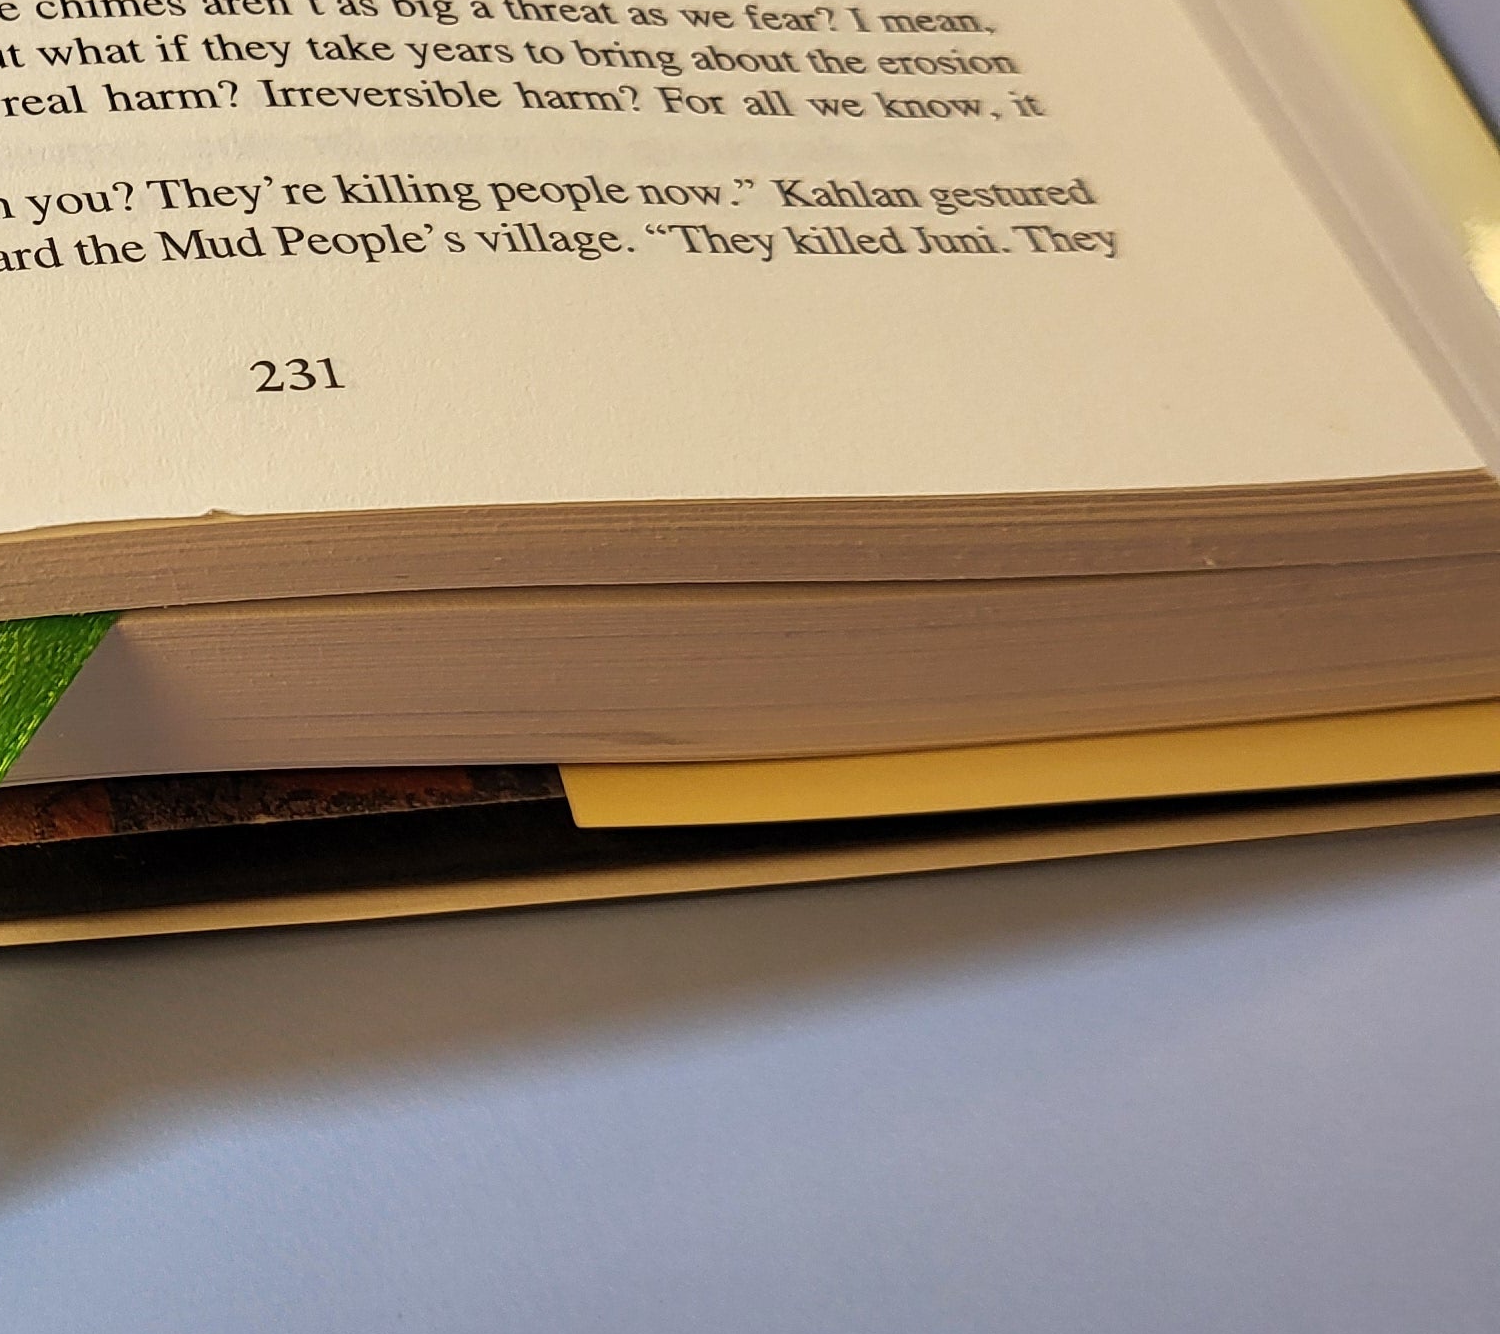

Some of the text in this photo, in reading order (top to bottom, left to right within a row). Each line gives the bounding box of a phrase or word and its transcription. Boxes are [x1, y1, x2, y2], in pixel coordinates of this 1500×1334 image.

[470, 0, 495, 20] a
[627, 6, 669, 27] as
[678, 9, 735, 29] we
[744, 2, 839, 32] fear?
[844, 6, 872, 33] I
[877, 14, 999, 36] mean,
[36, 36, 145, 67] what
[156, 33, 190, 63] if
[201, 33, 291, 69] they
[306, 33, 395, 61] take
[404, 42, 515, 70] years
[523, 40, 565, 65] to
[570, 39, 683, 77] bring
[690, 44, 802, 73] about
[805, 48, 869, 75] the
[877, 48, 1023, 76] erosion
[24, 181, 133, 226] you?
[332, 173, 481, 212] killing
[487, 174, 630, 212] people
[769, 178, 923, 208] Kahlan
[929, 176, 1099, 216] gestured
[74, 234, 147, 266] the
[153, 226, 267, 262] Mud
[474, 222, 636, 261] village.
[781, 225, 908, 255] killed
[909, 225, 1013, 254] Juni.
[1010, 224, 1119, 259] They
[250, 358, 345, 392] 231
